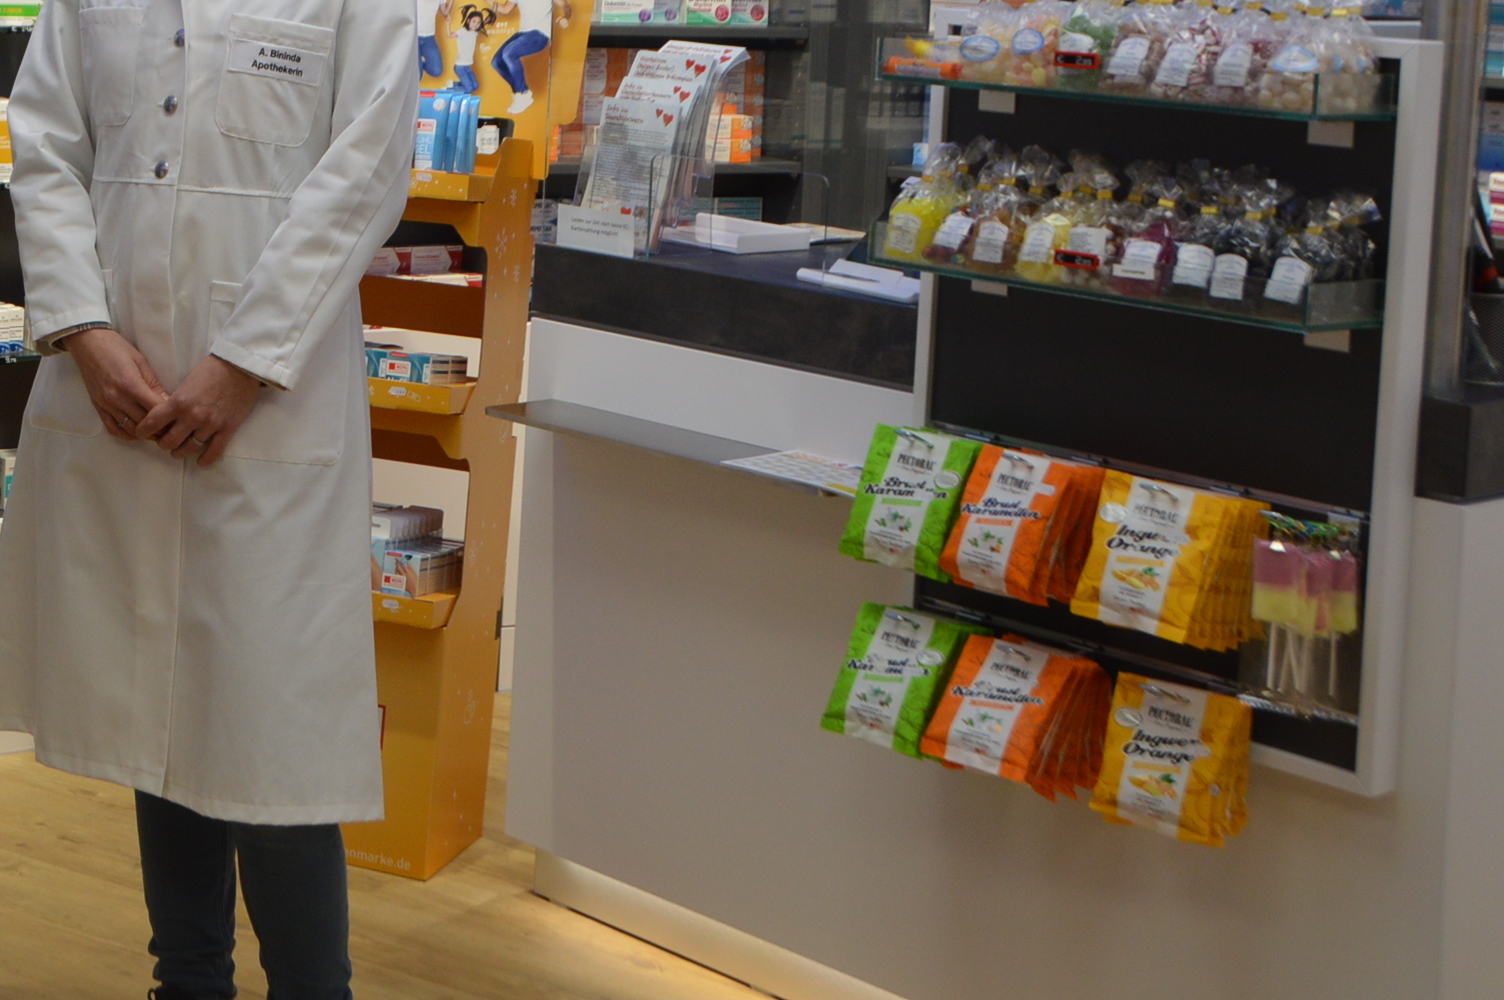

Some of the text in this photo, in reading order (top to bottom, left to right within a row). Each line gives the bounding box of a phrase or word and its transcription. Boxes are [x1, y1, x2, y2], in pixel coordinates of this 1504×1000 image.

[258, 47, 302, 63] A. Bininda
[251, 59, 304, 77] Apothekerin
[1123, 741, 1195, 765] Orange
